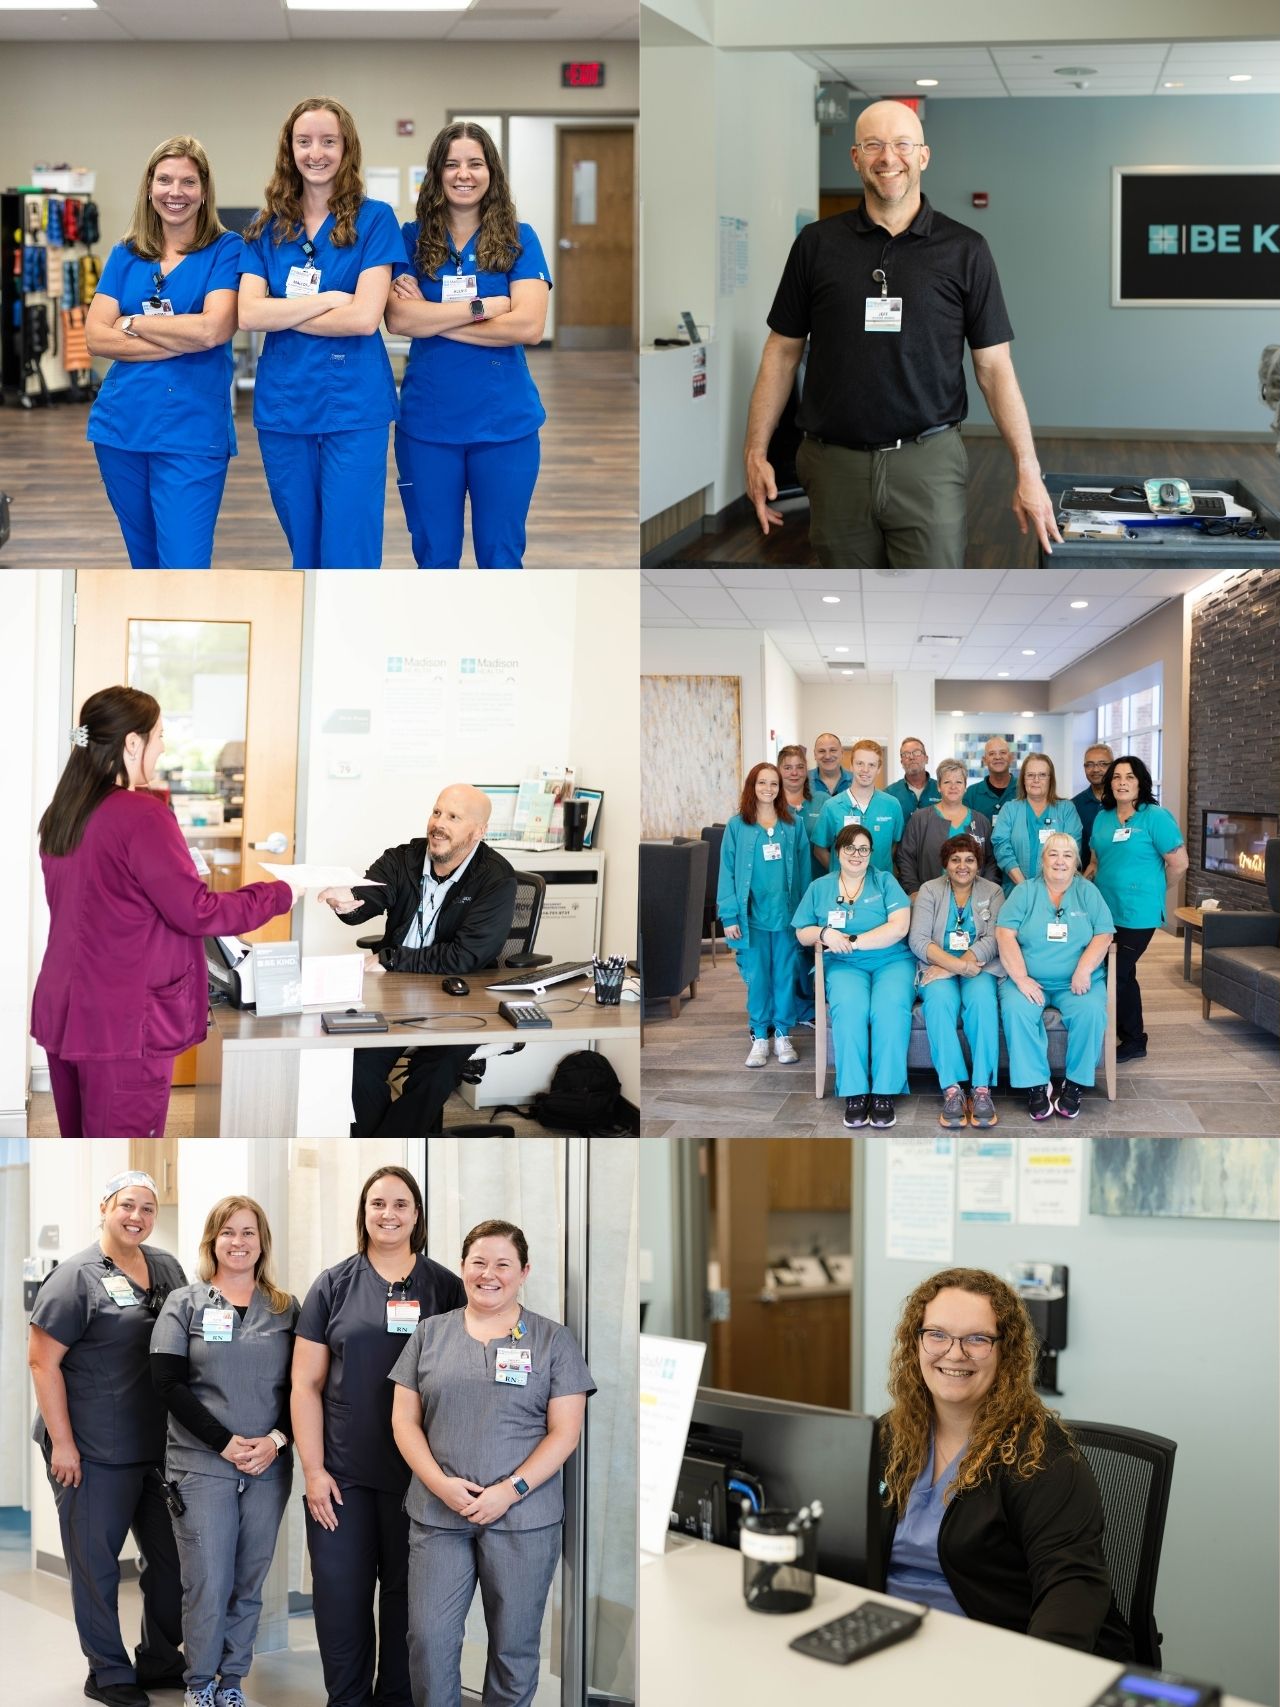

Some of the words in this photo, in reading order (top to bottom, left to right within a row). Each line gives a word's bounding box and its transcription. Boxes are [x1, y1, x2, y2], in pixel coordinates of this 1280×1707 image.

[1190, 224, 1241, 253] BE
[1253, 224, 1280, 253] K
[404, 657, 447, 668] Madison
[478, 657, 519, 668] Madison
[339, 764, 352, 774] 79
